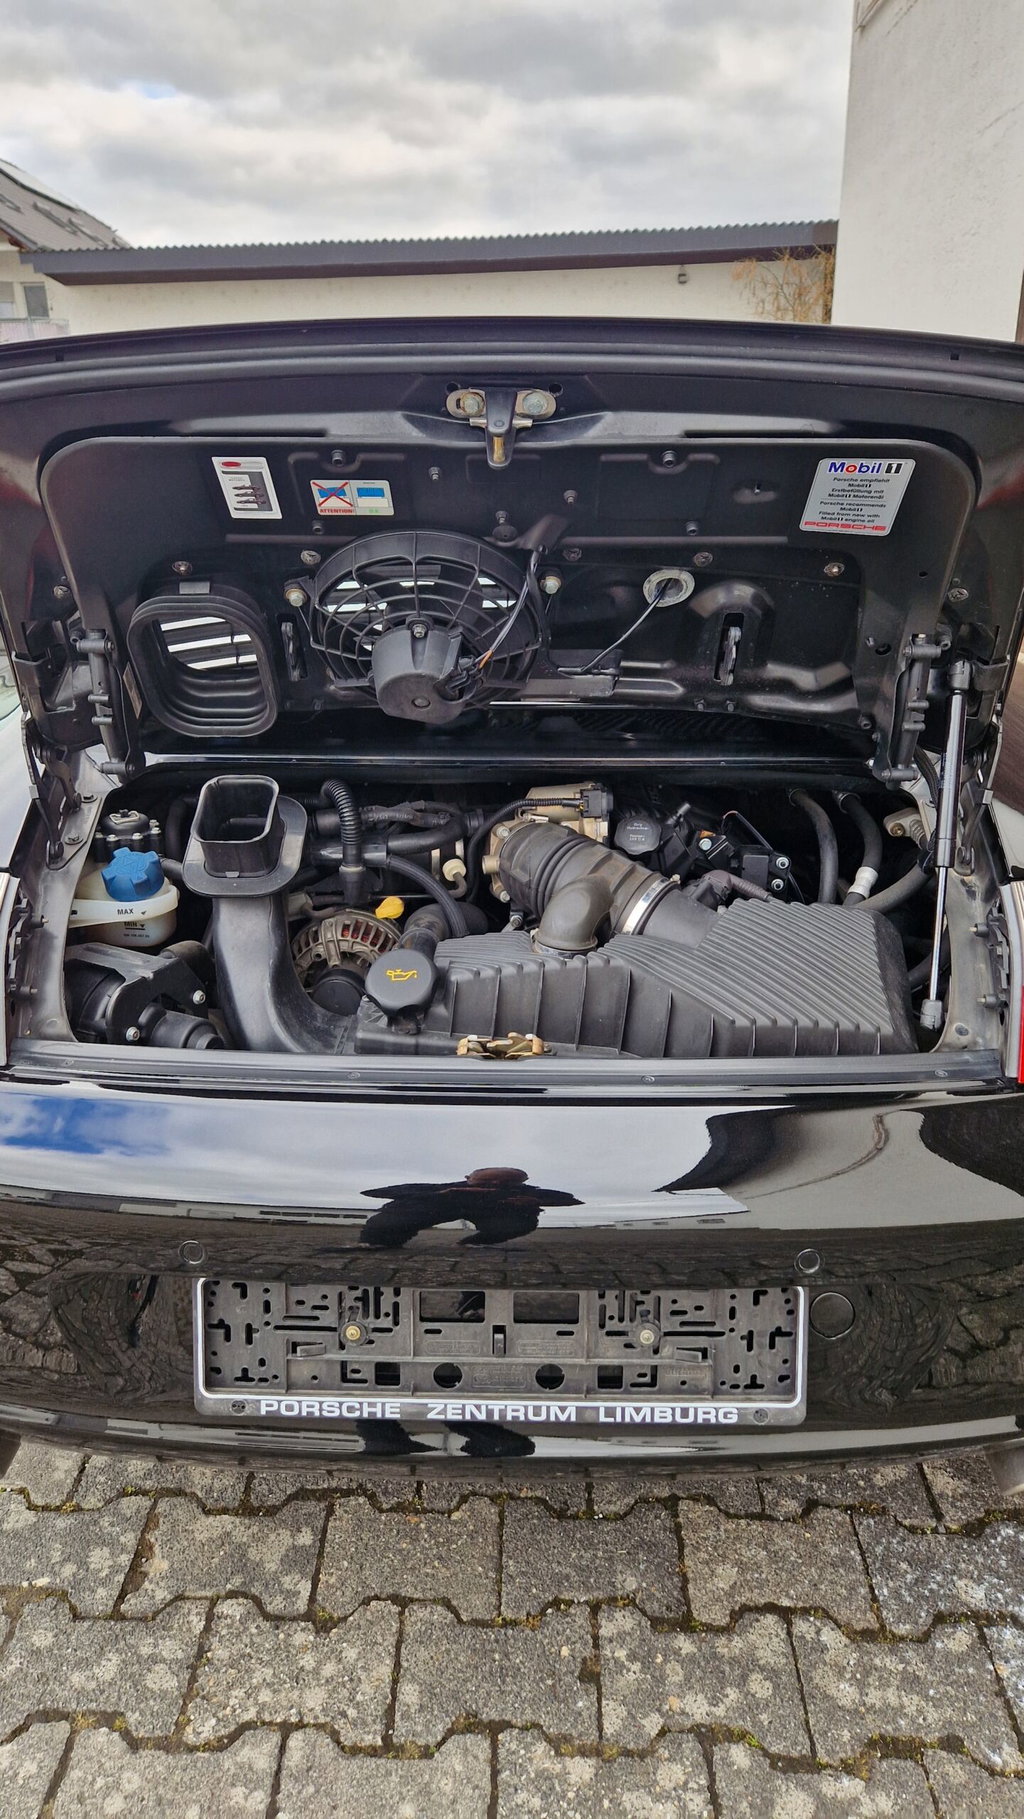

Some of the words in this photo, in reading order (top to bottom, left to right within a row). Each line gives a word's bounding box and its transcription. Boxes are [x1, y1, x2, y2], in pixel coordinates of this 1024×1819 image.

[828, 461, 882, 474] Mobil
[886, 463, 901, 474] 1
[804, 521, 886, 531] PORSCHE
[260, 1399, 401, 1419] PORSCHE
[426, 1402, 577, 1423] ZENTRUM
[599, 1404, 739, 1426] LIMBURG
